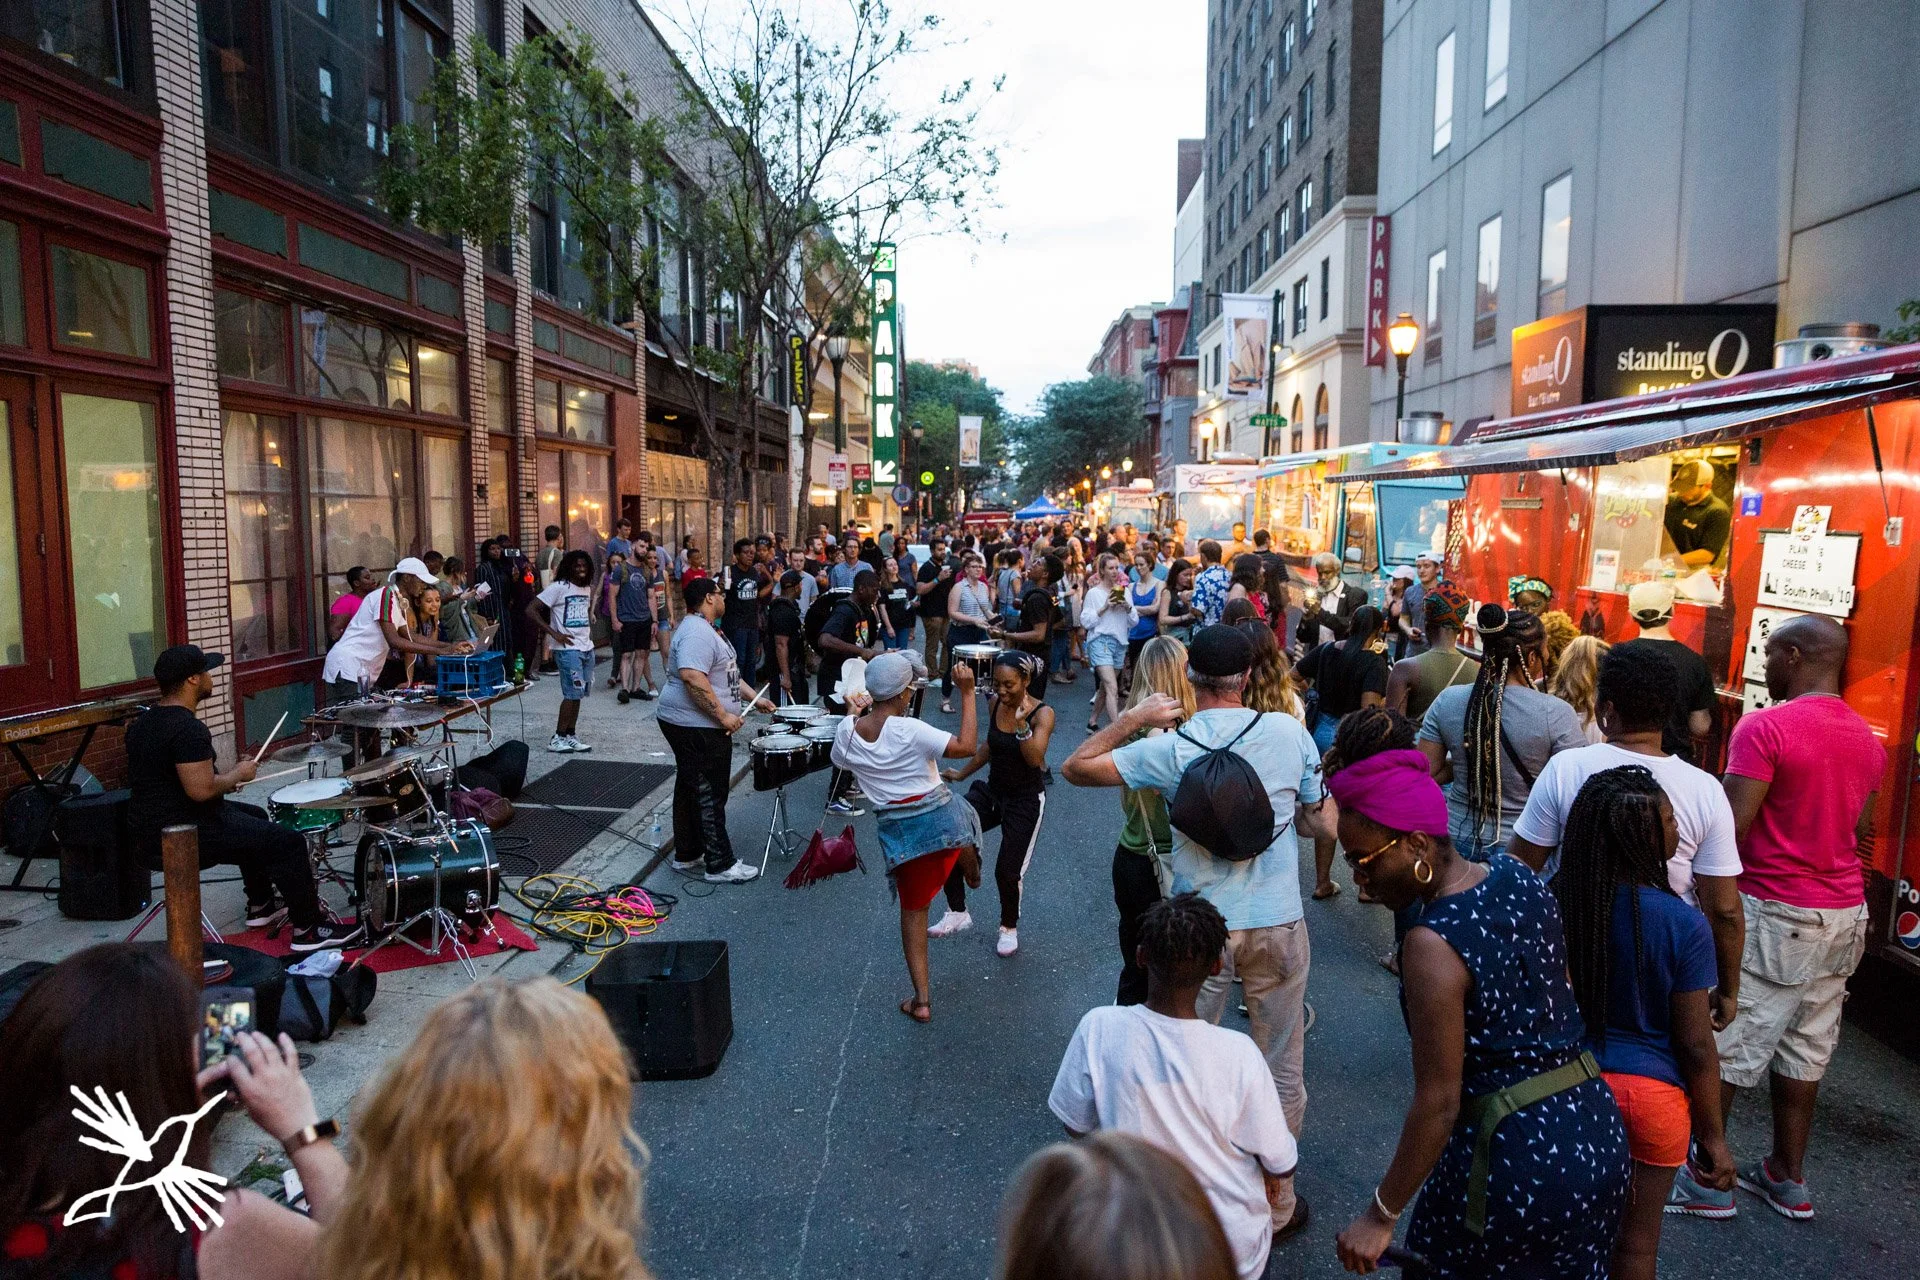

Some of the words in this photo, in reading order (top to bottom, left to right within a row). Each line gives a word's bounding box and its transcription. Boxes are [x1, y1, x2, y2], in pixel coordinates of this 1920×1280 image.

[1371, 221, 1386, 329] PARK
[875, 278, 894, 438] PARK
[1788, 544, 1808, 555] PLAIN
[1782, 558, 1806, 570] CHEESE
[1783, 584, 1808, 598] South
[1810, 587, 1835, 606] Philly
[4, 724, 41, 740] Roland
